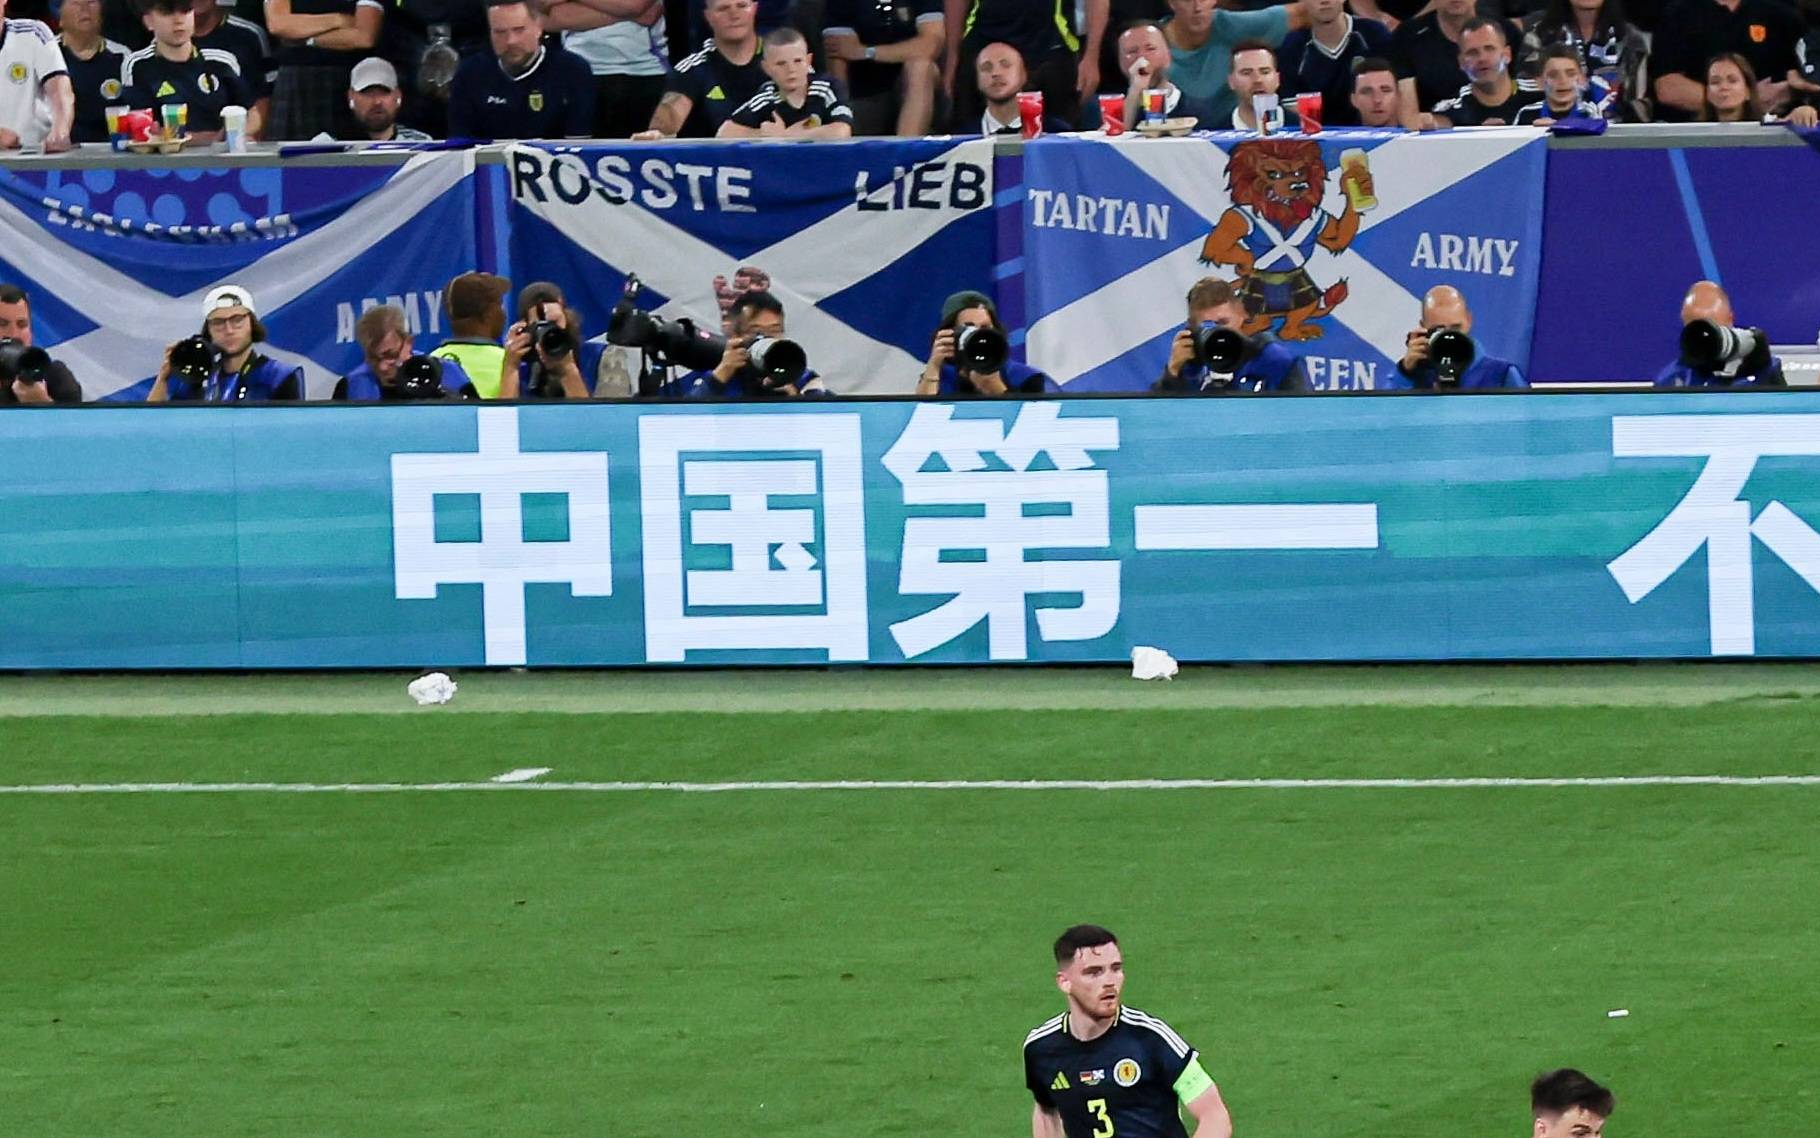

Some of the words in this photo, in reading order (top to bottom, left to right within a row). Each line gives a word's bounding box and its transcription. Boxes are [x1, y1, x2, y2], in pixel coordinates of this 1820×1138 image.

[855, 162, 986, 212] LIEB
[1028, 188, 1171, 240] TARTAN
[1410, 232, 1519, 277] ARMY
[336, 290, 443, 344] AMY
[390, 401, 1378, 666] 中国第一
